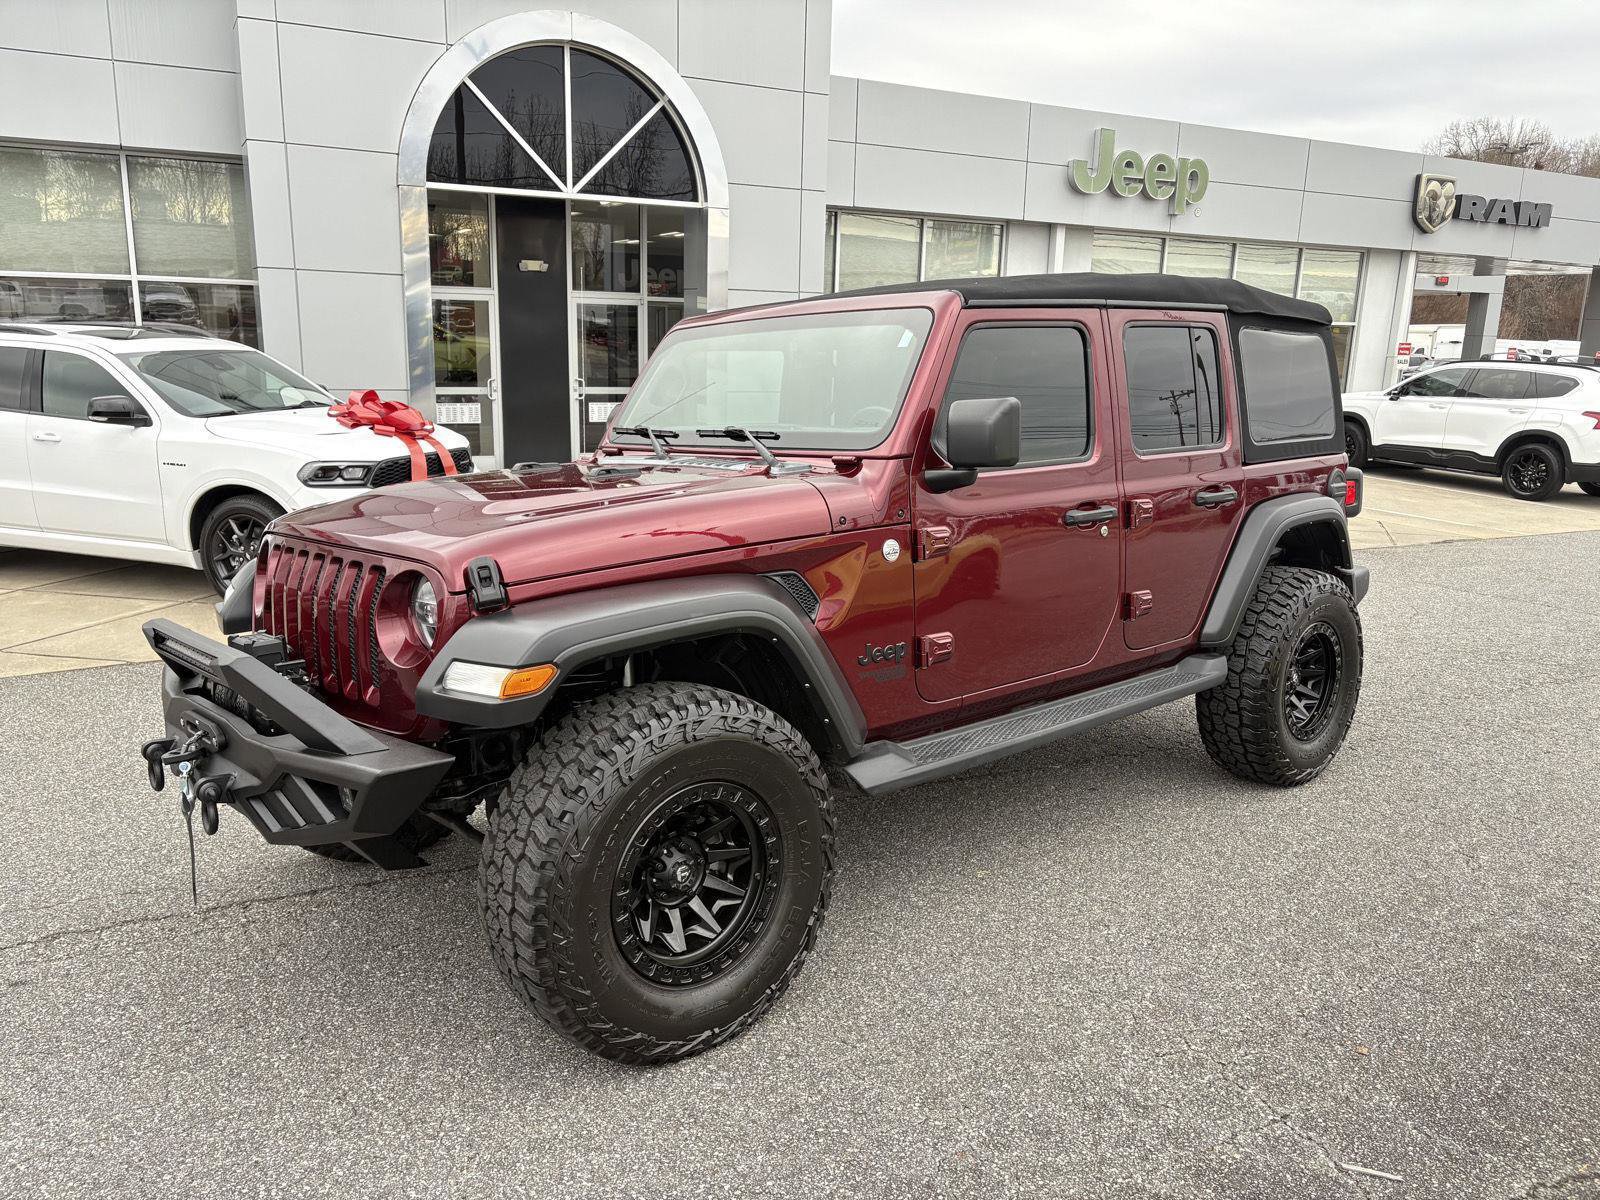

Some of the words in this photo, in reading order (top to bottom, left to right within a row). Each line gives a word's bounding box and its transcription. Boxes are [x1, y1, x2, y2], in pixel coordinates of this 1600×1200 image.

[1067, 127, 1210, 215] Jeep
[1453, 194, 1553, 228] RAM
[857, 641, 907, 667] Jeep
